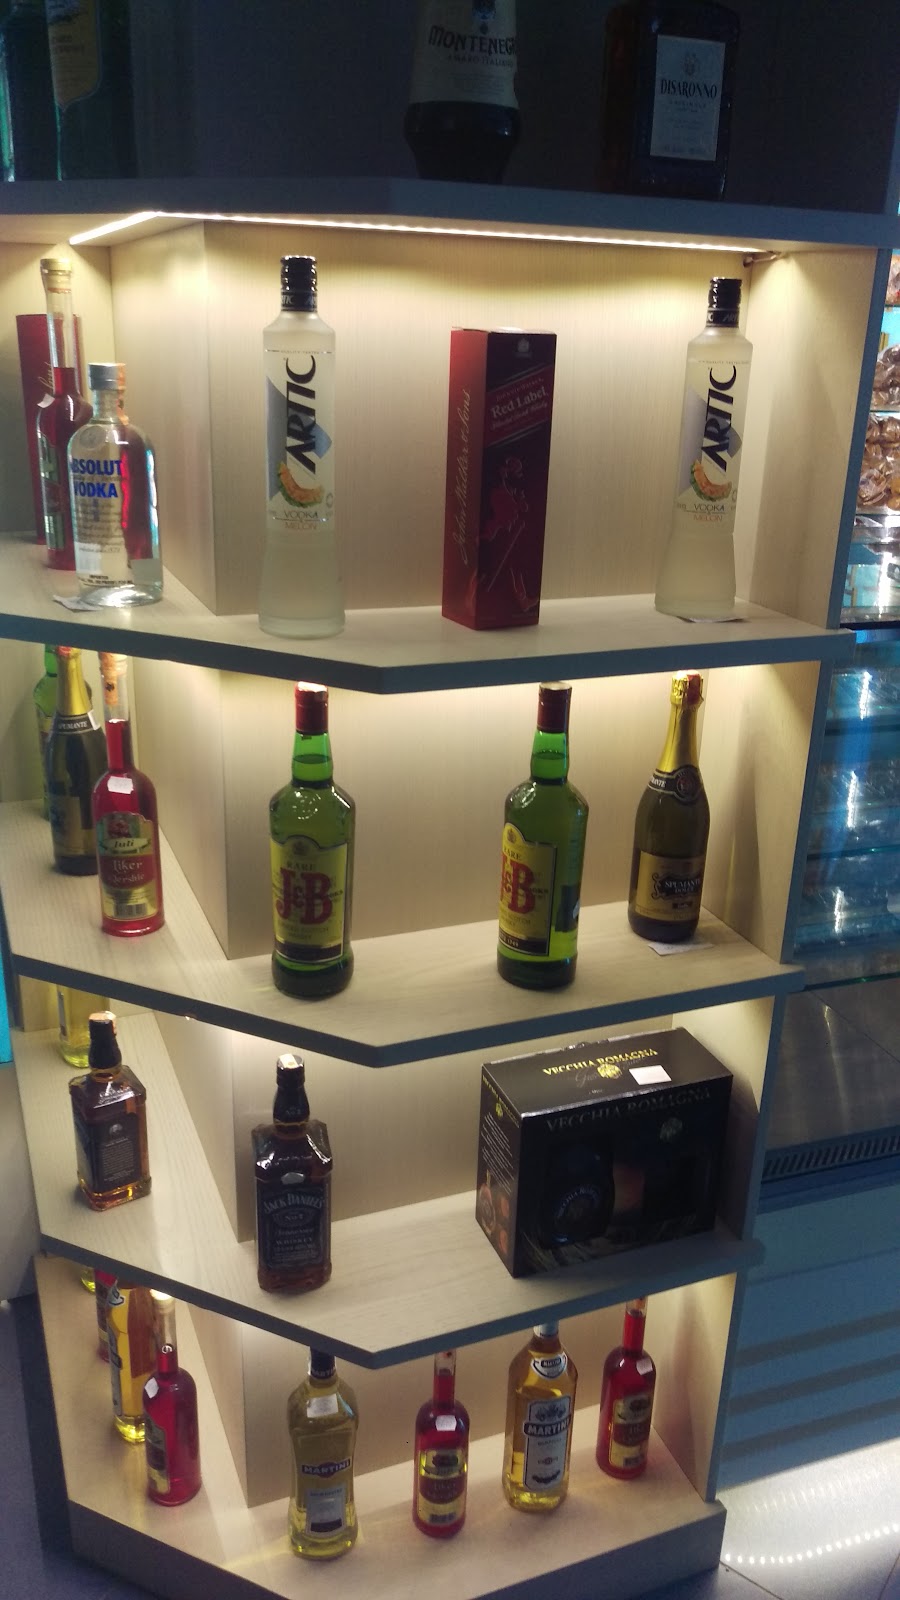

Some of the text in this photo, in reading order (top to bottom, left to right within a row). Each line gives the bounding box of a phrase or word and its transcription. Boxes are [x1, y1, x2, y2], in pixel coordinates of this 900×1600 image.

[428, 25, 517, 55] MONTENEG
[660, 79, 717, 98] DISARONNO
[285, 354, 317, 476] ARTIC
[489, 400, 515, 419] Red
[701, 364, 738, 473] ARTIC
[71, 457, 122, 476] BSOLUT
[284, 509, 319, 519] VODKA
[693, 502, 725, 512] VODKA
[276, 867, 333, 925] J&B
[543, 1058, 597, 1077] VECCHIA
[596, 1047, 659, 1066] ROMAGNA
[546, 1085, 711, 1133] VECCHIA ROMAGNA
[263, 1198, 287, 1214] JACK
[527, 1418, 570, 1436] MARTINI
[304, 1458, 350, 1474] MARTINI
